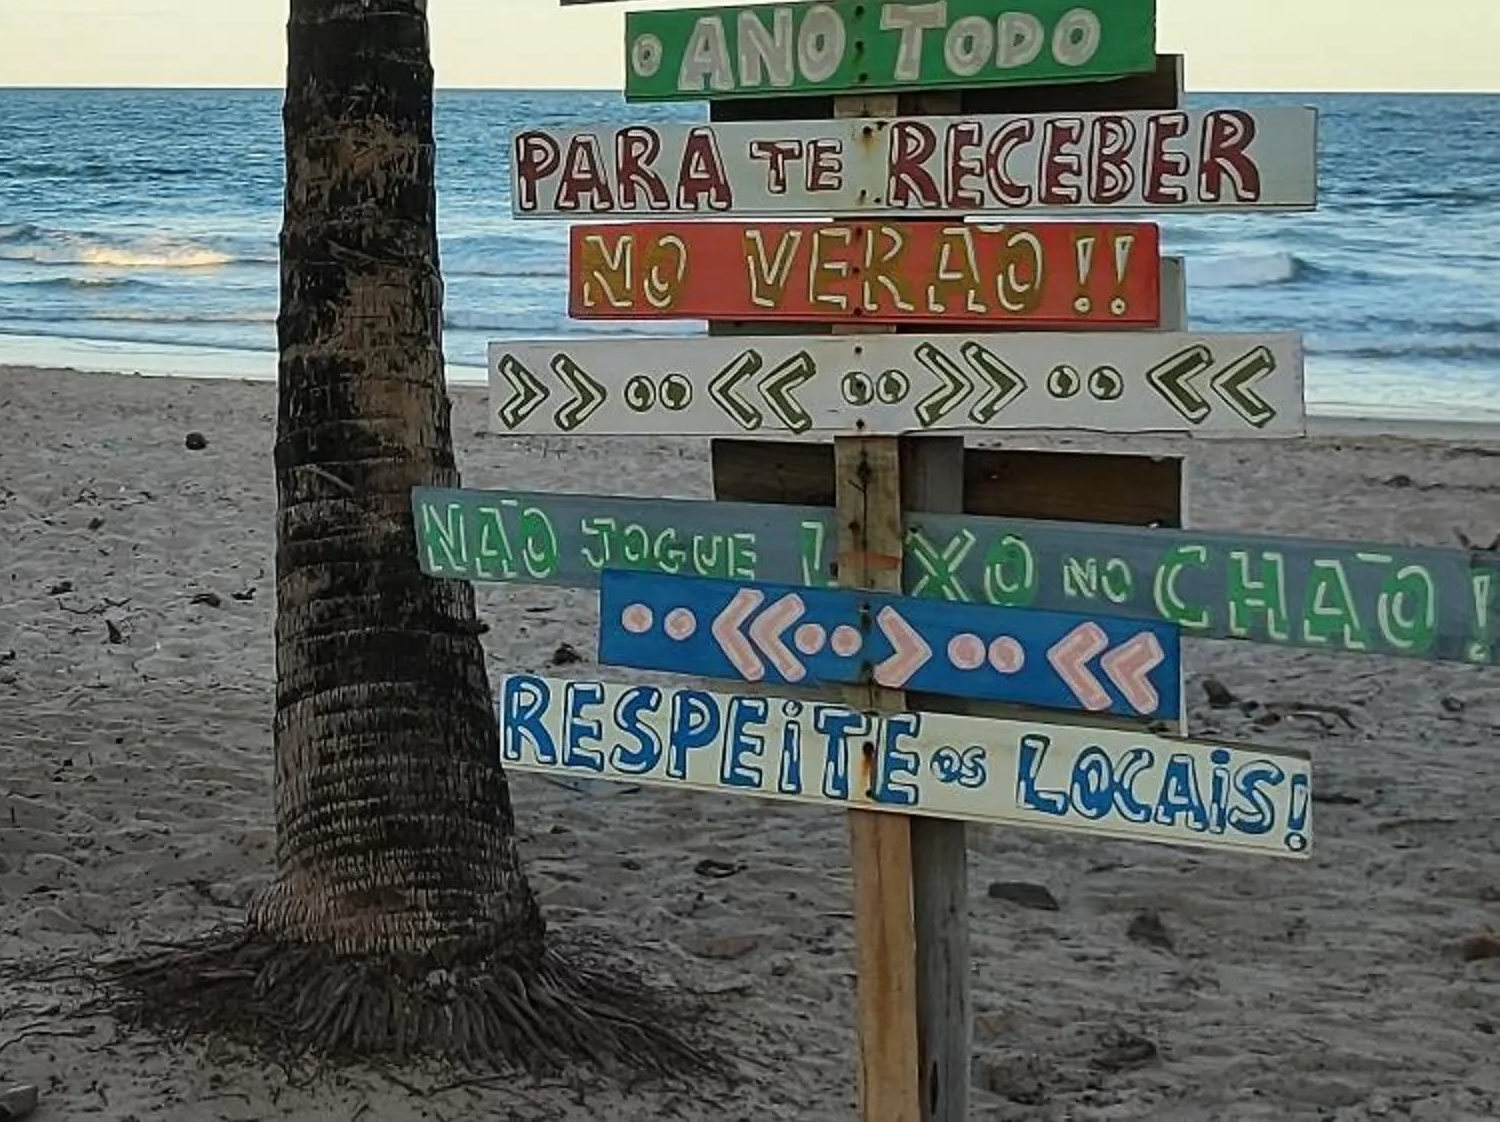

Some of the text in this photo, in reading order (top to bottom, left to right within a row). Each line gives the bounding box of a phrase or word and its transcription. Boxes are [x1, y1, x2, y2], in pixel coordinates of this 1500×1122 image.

[677, 3, 848, 93] ANO
[514, 109, 1263, 212] PARA TE RECEBER
[579, 233, 688, 310] NO
[420, 498, 559, 580] NÃO
[579, 516, 757, 582] JOGUE
[799, 519, 1037, 607] LXO
[1061, 556, 1133, 604] NO
